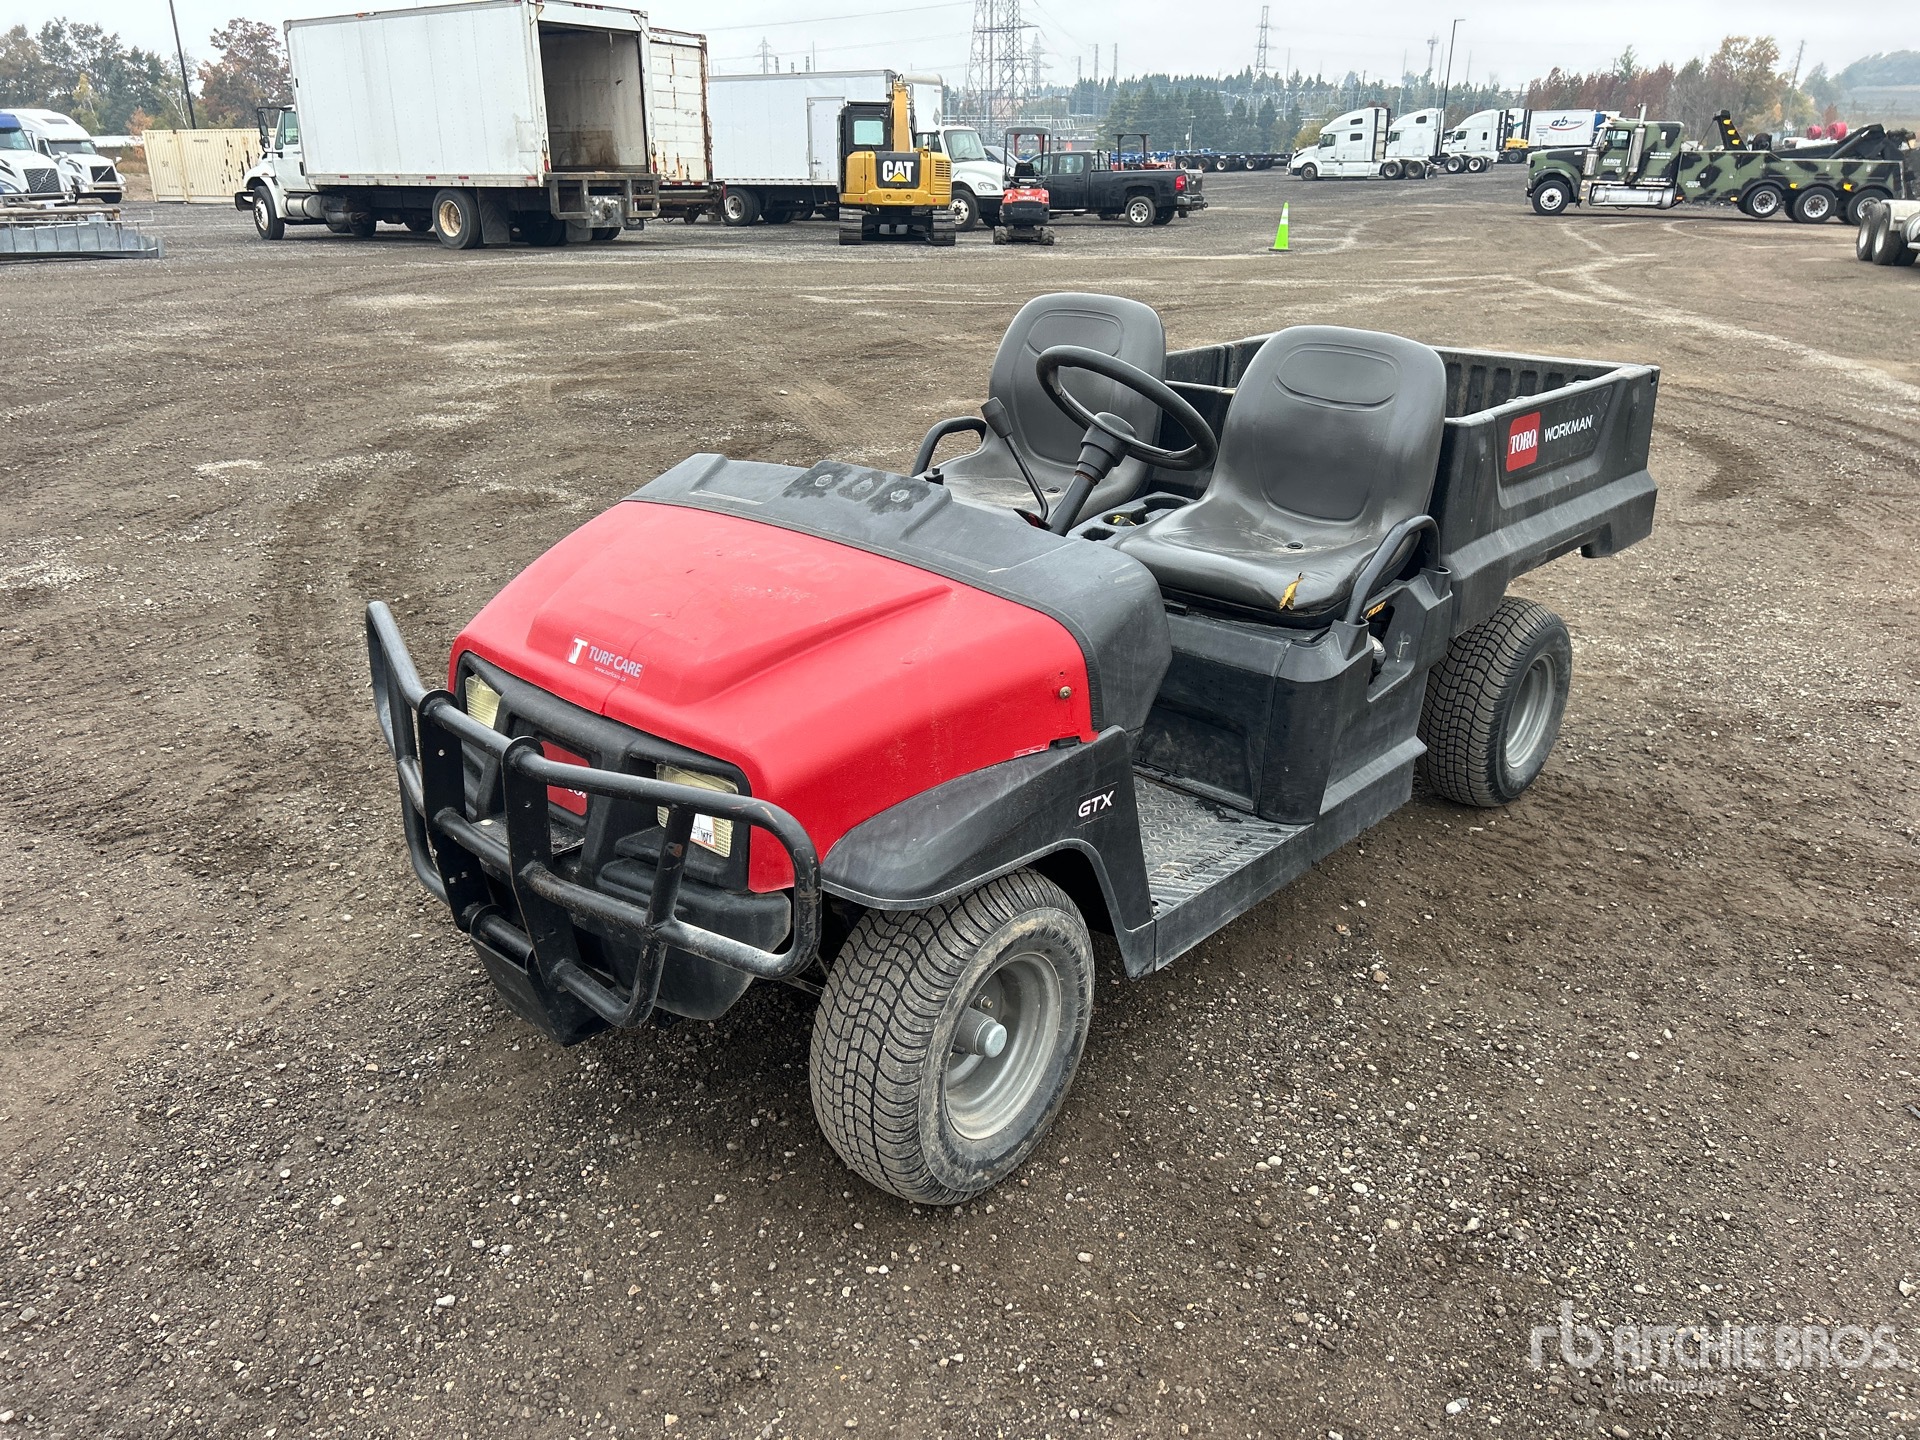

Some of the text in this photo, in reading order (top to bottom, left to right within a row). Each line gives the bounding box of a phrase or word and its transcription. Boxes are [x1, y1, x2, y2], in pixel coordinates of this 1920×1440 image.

[882, 160, 914, 182] CAT
[1544, 414, 1594, 443] WORKMAN
[1078, 790, 1114, 817] GTX
